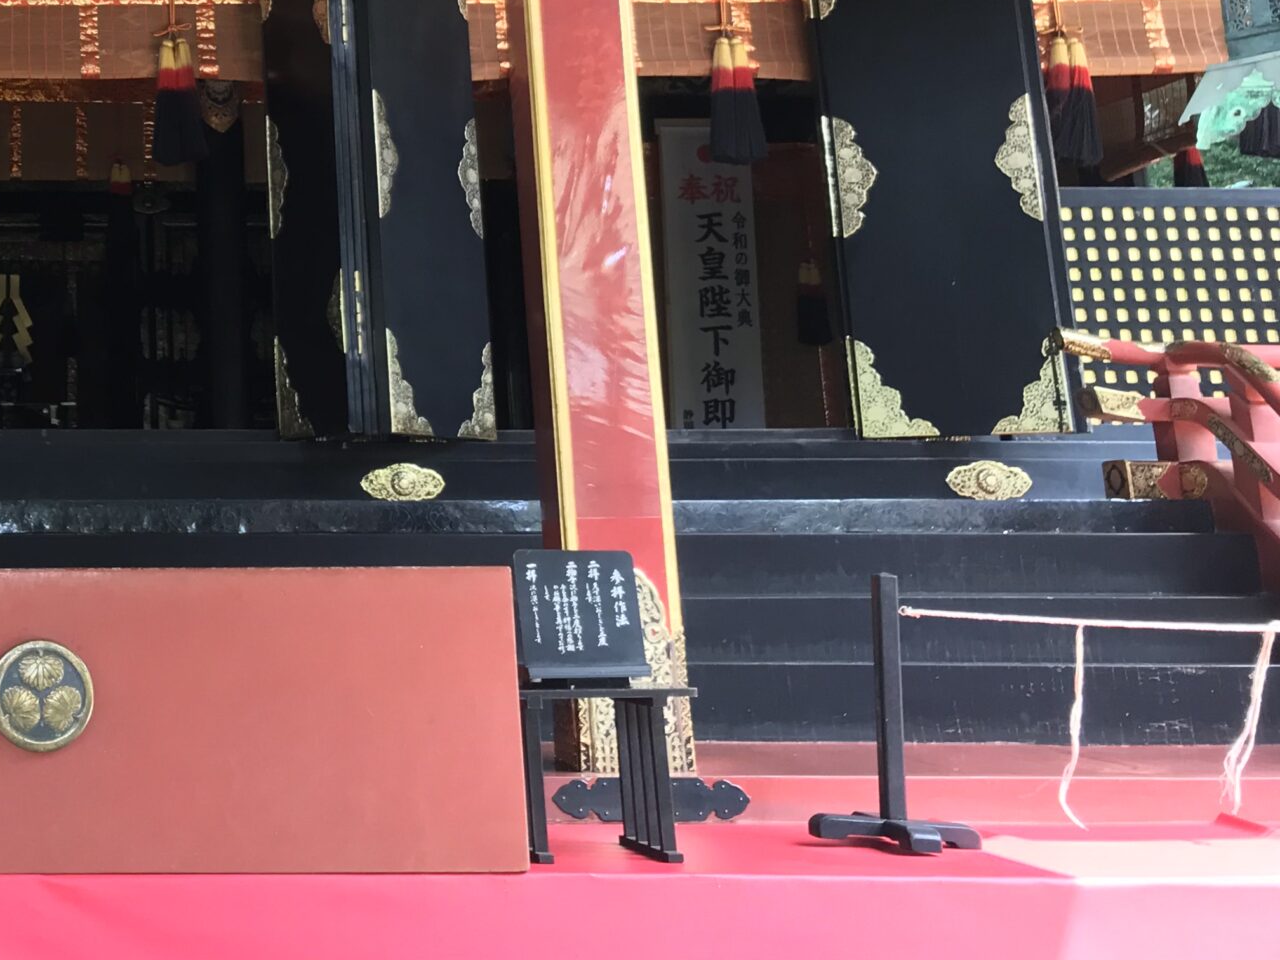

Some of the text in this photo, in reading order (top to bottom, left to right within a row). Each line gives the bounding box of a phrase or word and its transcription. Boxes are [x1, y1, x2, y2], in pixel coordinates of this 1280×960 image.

[678, 173, 742, 205] 奉祝
[694, 212, 736, 429] 天皇陛下御即
[731, 210, 753, 327] 令和の御大典
